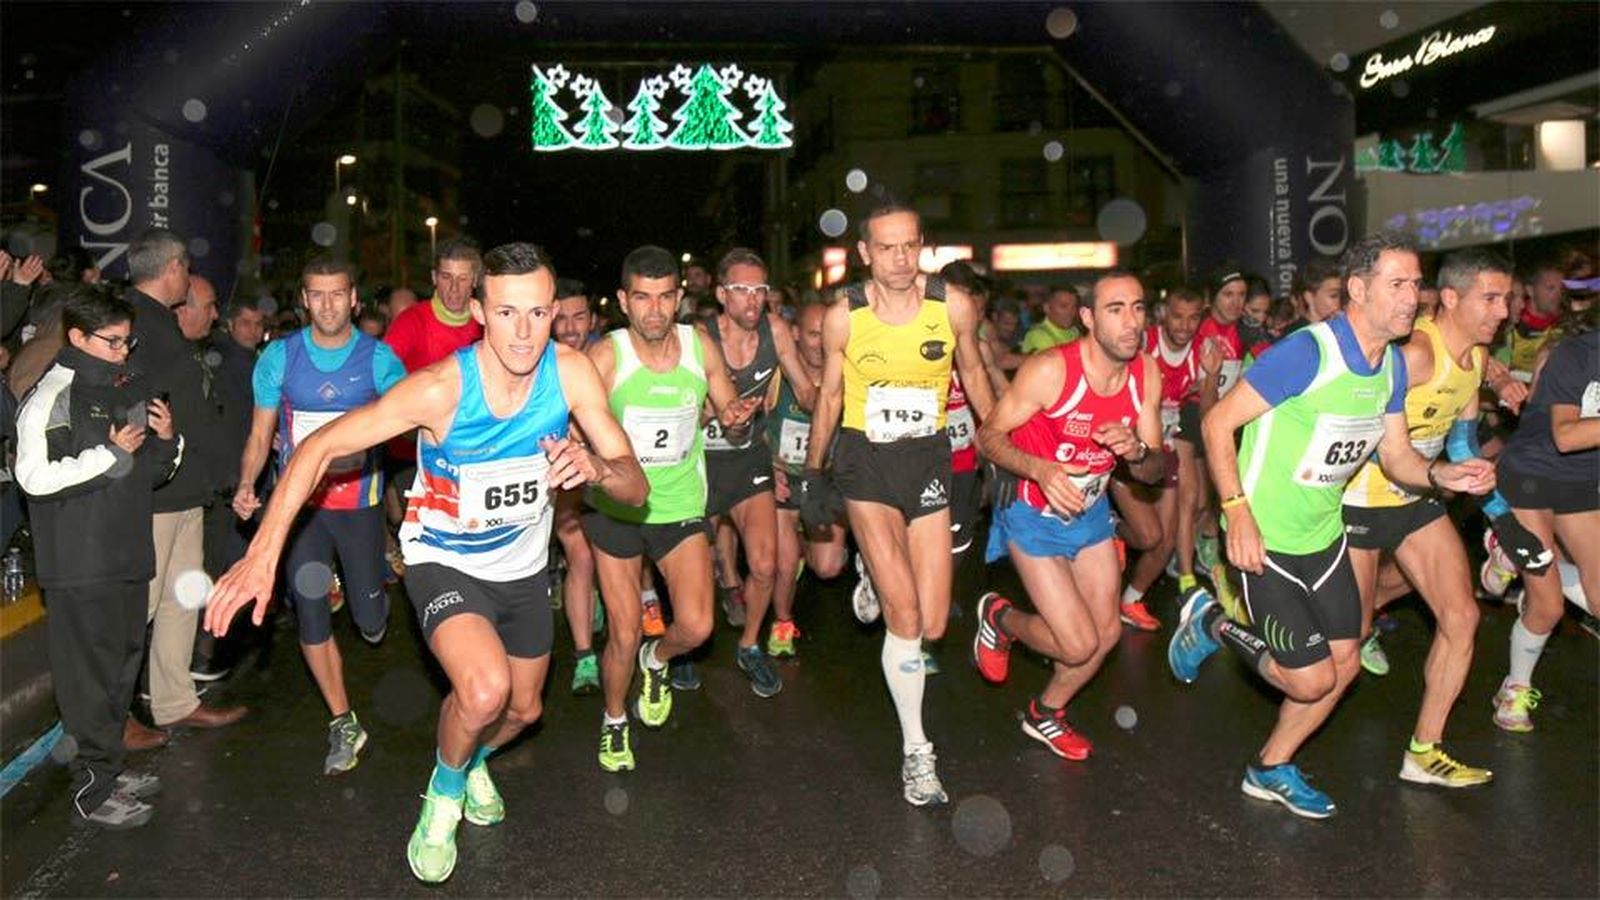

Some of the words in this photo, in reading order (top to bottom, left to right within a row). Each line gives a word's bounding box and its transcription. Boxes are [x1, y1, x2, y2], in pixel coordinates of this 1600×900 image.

[148, 143, 170, 208] banca
[1274, 158, 1289, 195] una
[1275, 199, 1292, 259] nueva
[654, 429, 669, 449] 2
[1324, 440, 1367, 466] 633
[484, 479, 539, 511] 655
[920, 496, 948, 508] Sevilla
